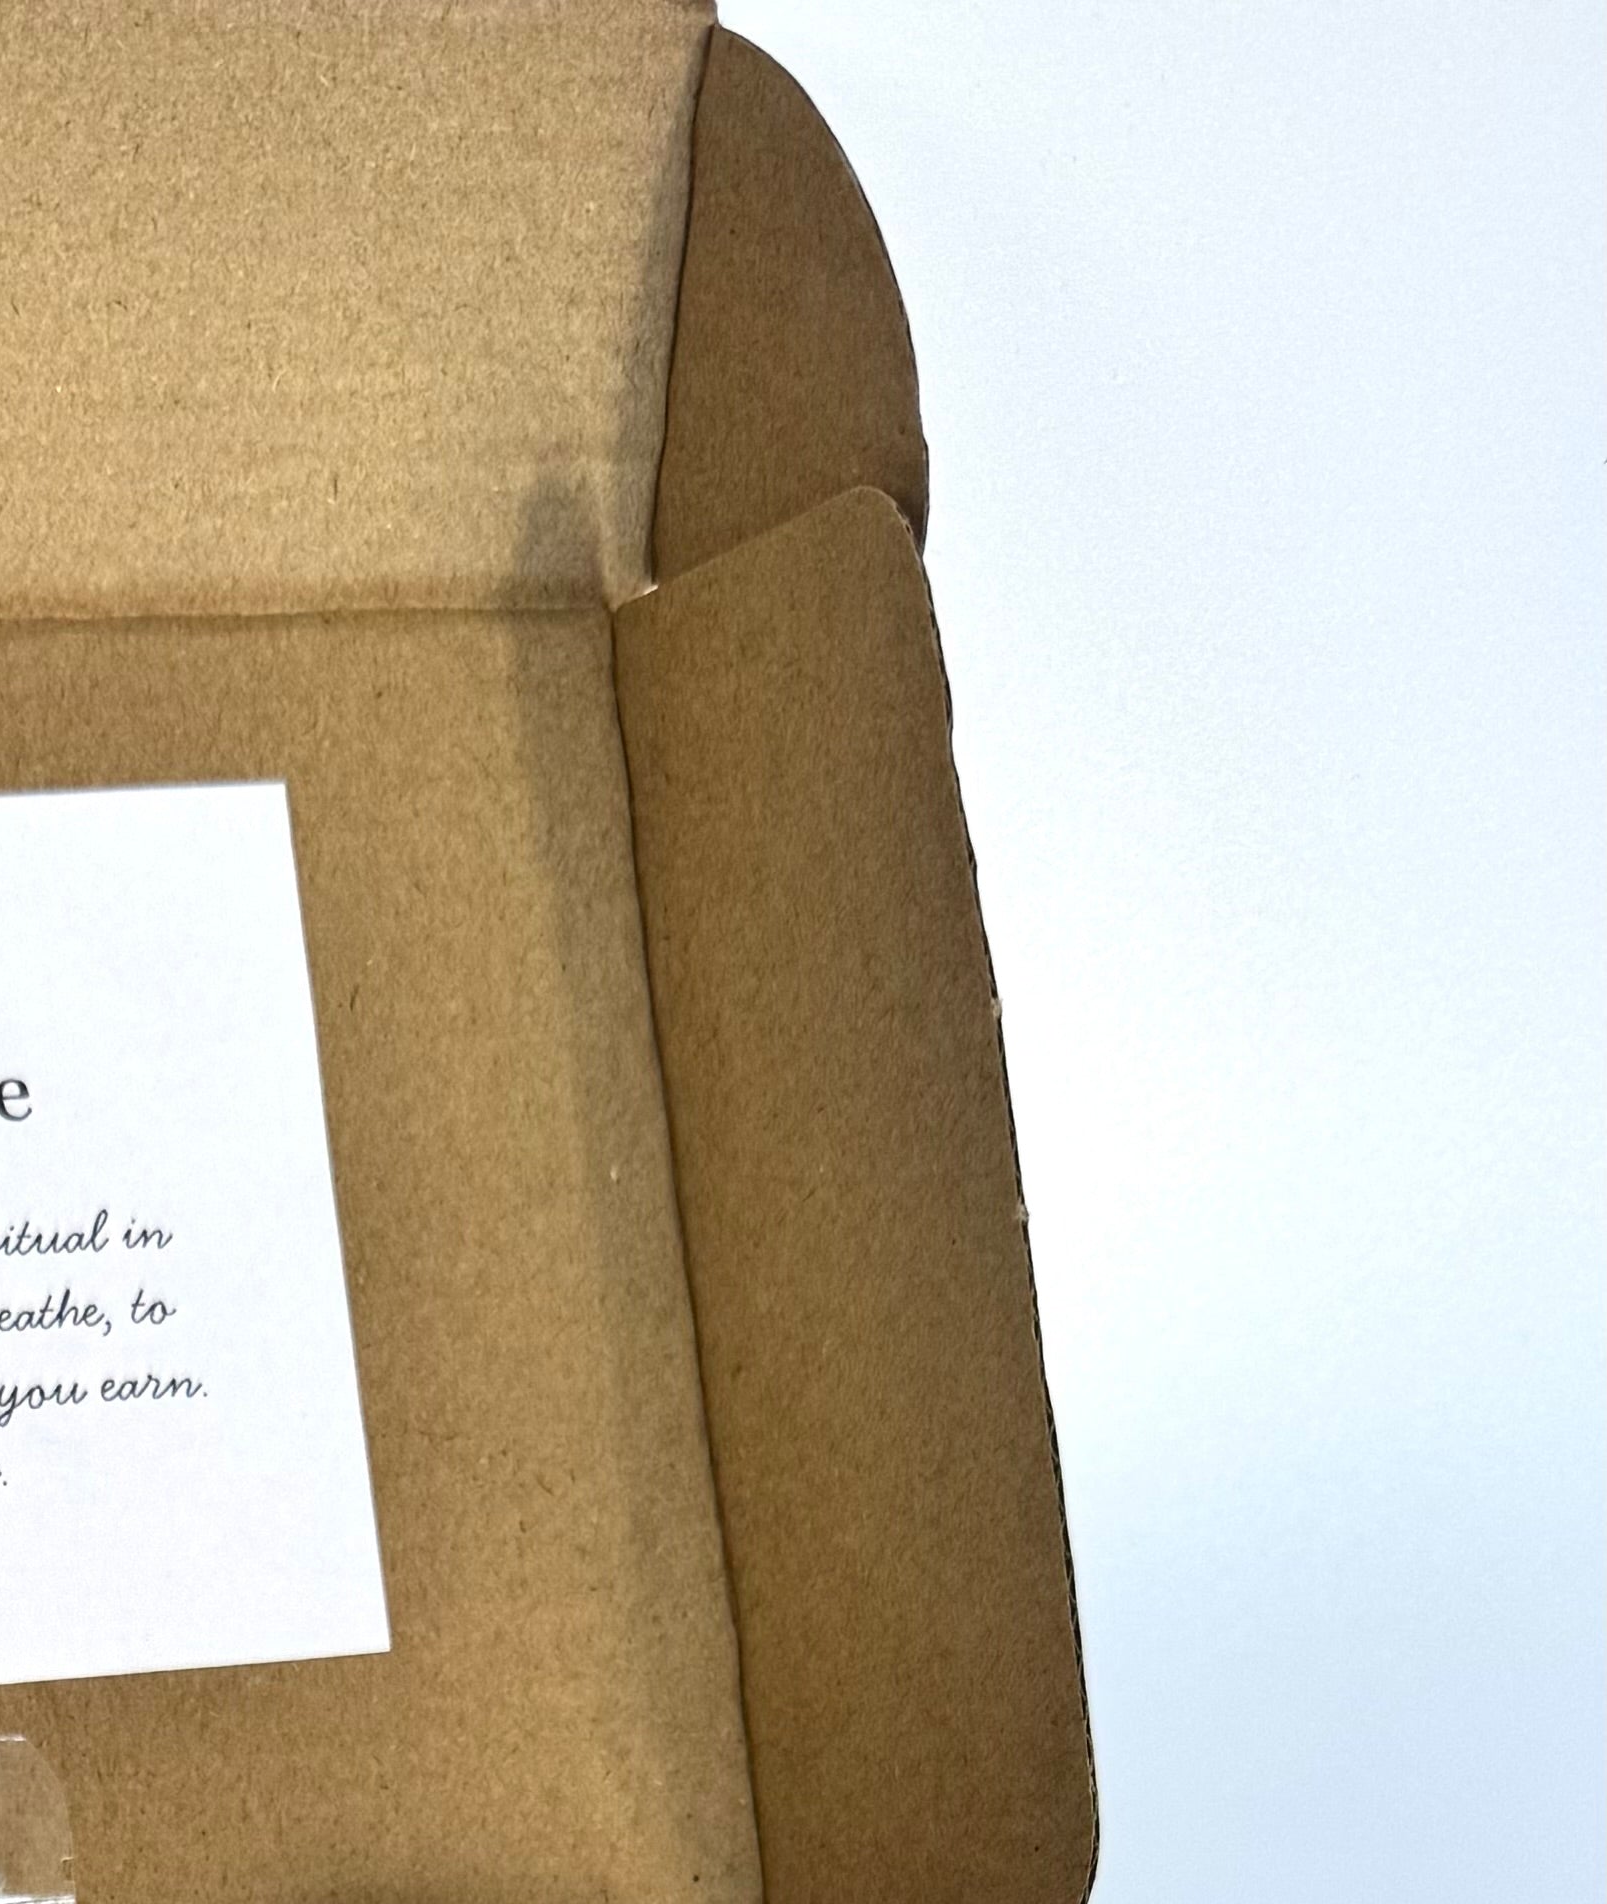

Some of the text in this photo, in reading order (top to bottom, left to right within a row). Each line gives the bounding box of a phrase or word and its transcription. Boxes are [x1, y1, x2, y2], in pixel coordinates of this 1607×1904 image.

[120, 1216, 175, 1251] in
[129, 1286, 178, 1326] to
[99, 1372, 209, 1403] earn.
